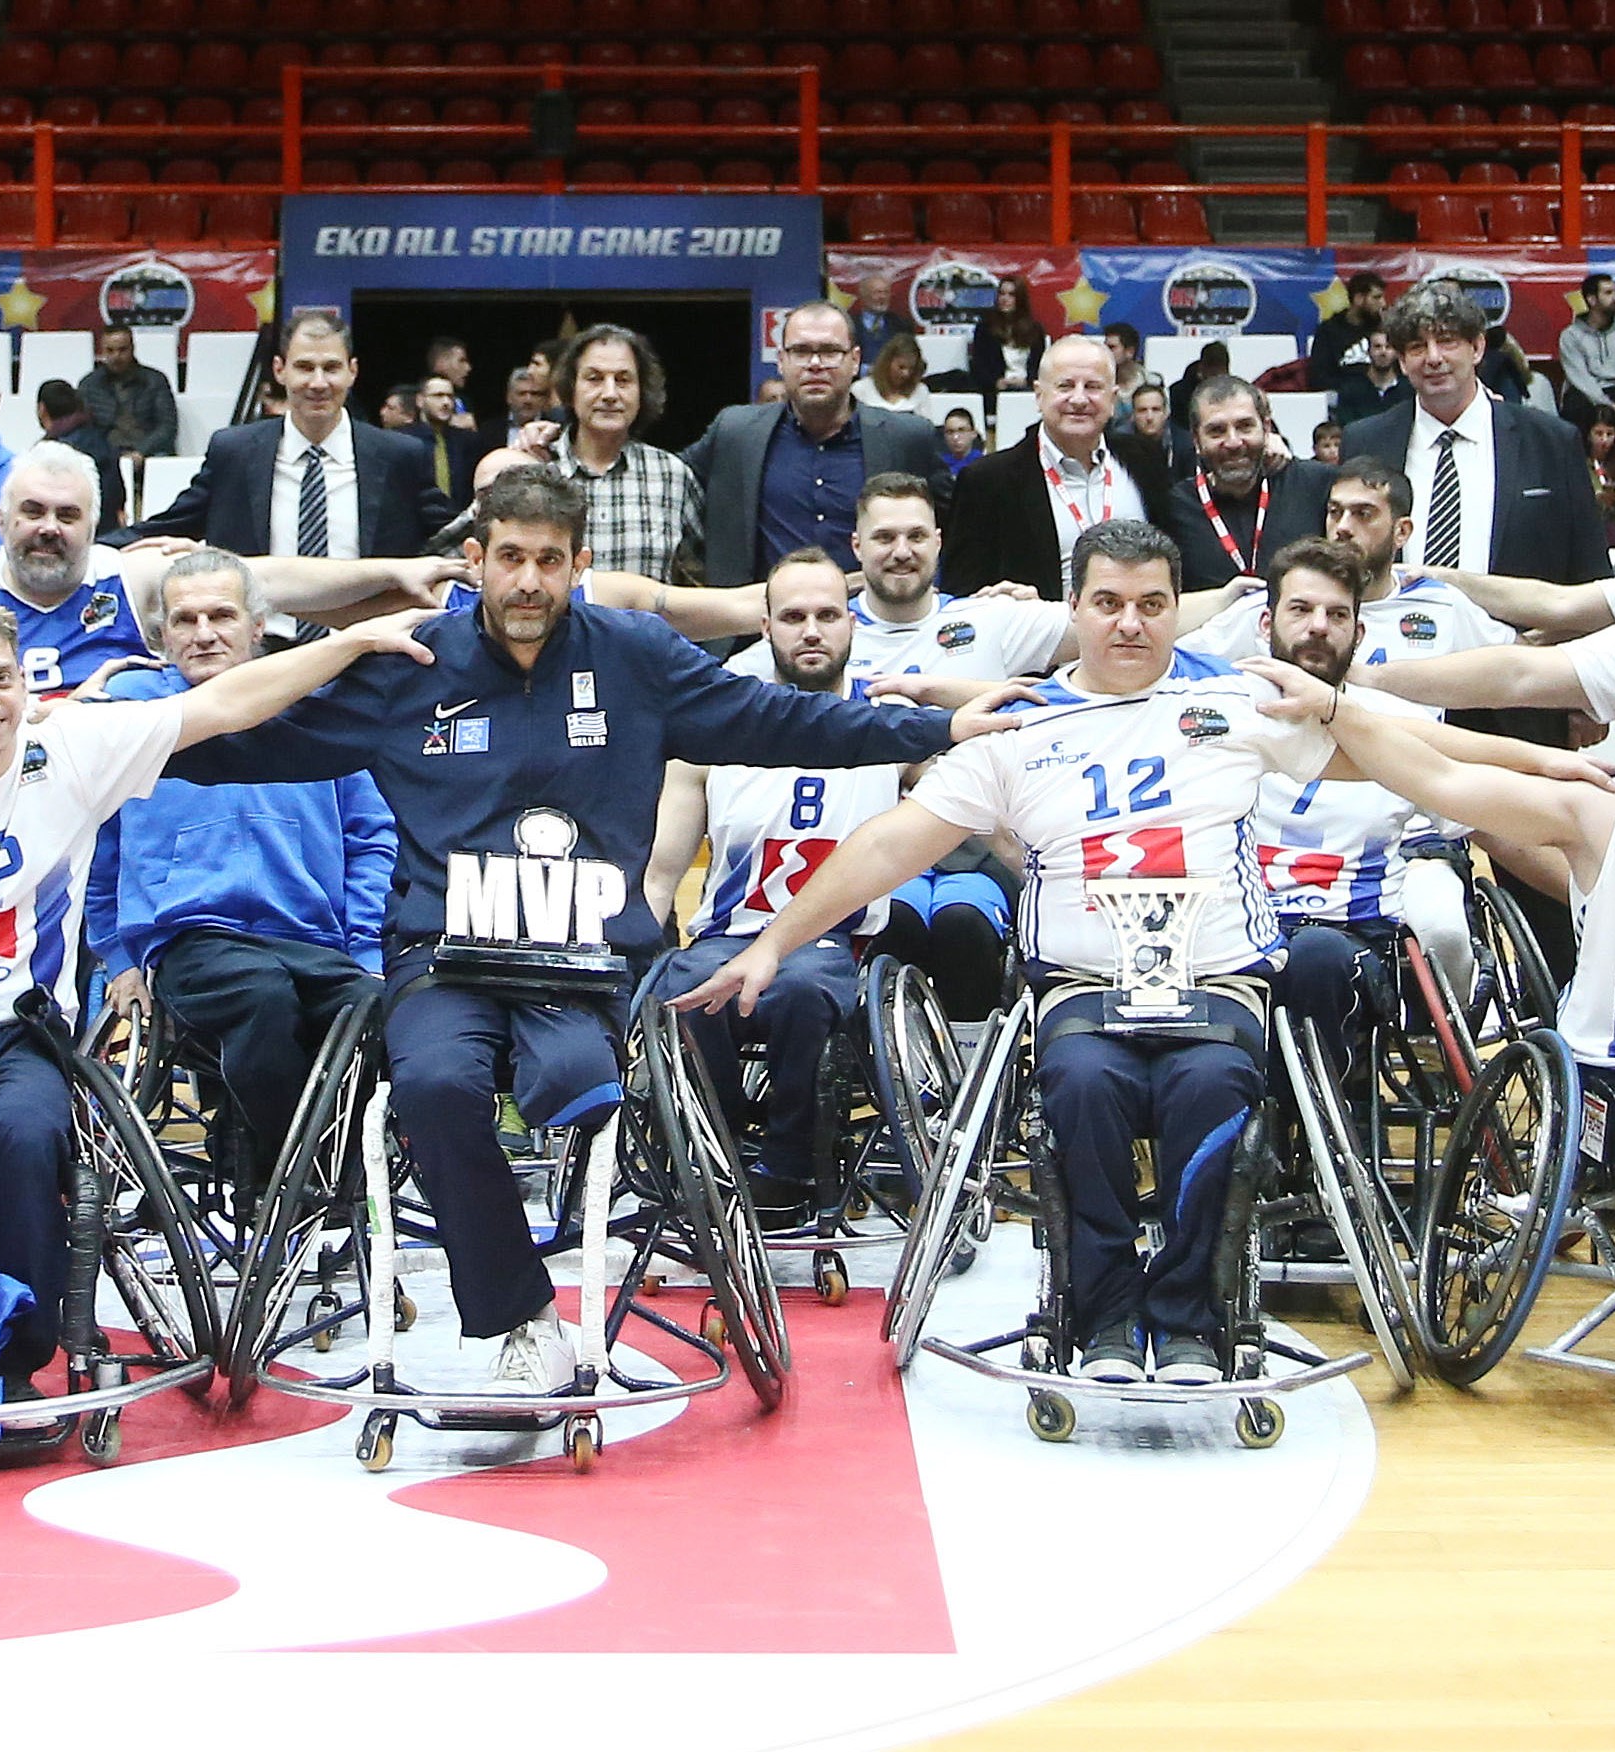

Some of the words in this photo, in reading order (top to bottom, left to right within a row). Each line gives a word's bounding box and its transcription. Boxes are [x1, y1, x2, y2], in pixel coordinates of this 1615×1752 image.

[314, 226, 391, 256] EKO
[394, 226, 460, 256] ALL
[469, 226, 573, 256] STAR
[578, 226, 684, 256] GAME
[687, 226, 782, 256] 2018
[23, 647, 63, 692] 8
[790, 777, 824, 830] 8
[1083, 756, 1171, 821] 12
[446, 850, 627, 945] MVP
[1267, 894, 1326, 909] EKO
